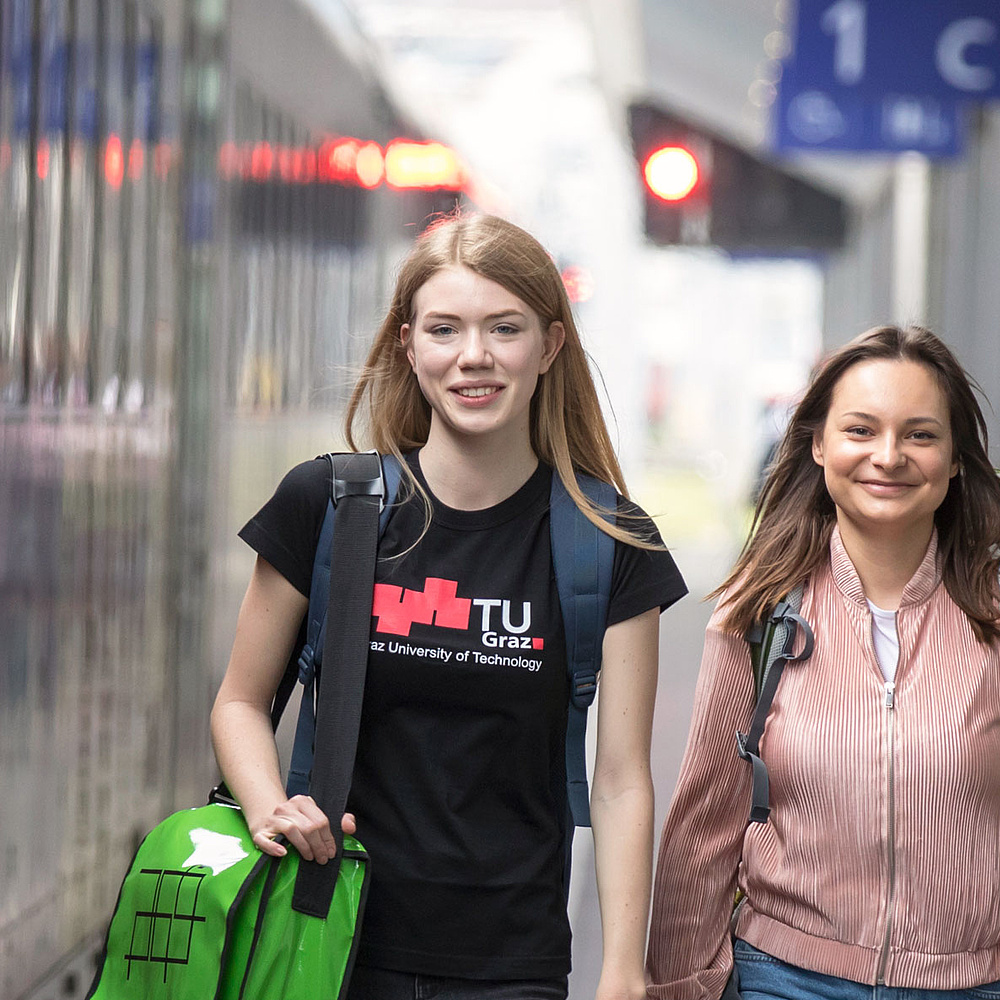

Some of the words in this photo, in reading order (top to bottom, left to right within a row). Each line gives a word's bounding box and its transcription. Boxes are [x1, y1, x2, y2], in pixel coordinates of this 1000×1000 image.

[819, 0, 867, 85] 1
[934, 16, 997, 92] C
[473, 598, 531, 634] TU
[369, 641, 385, 652] az
[388, 641, 452, 663] University
[455, 650, 470, 662] of
[472, 651, 542, 672] Technology
